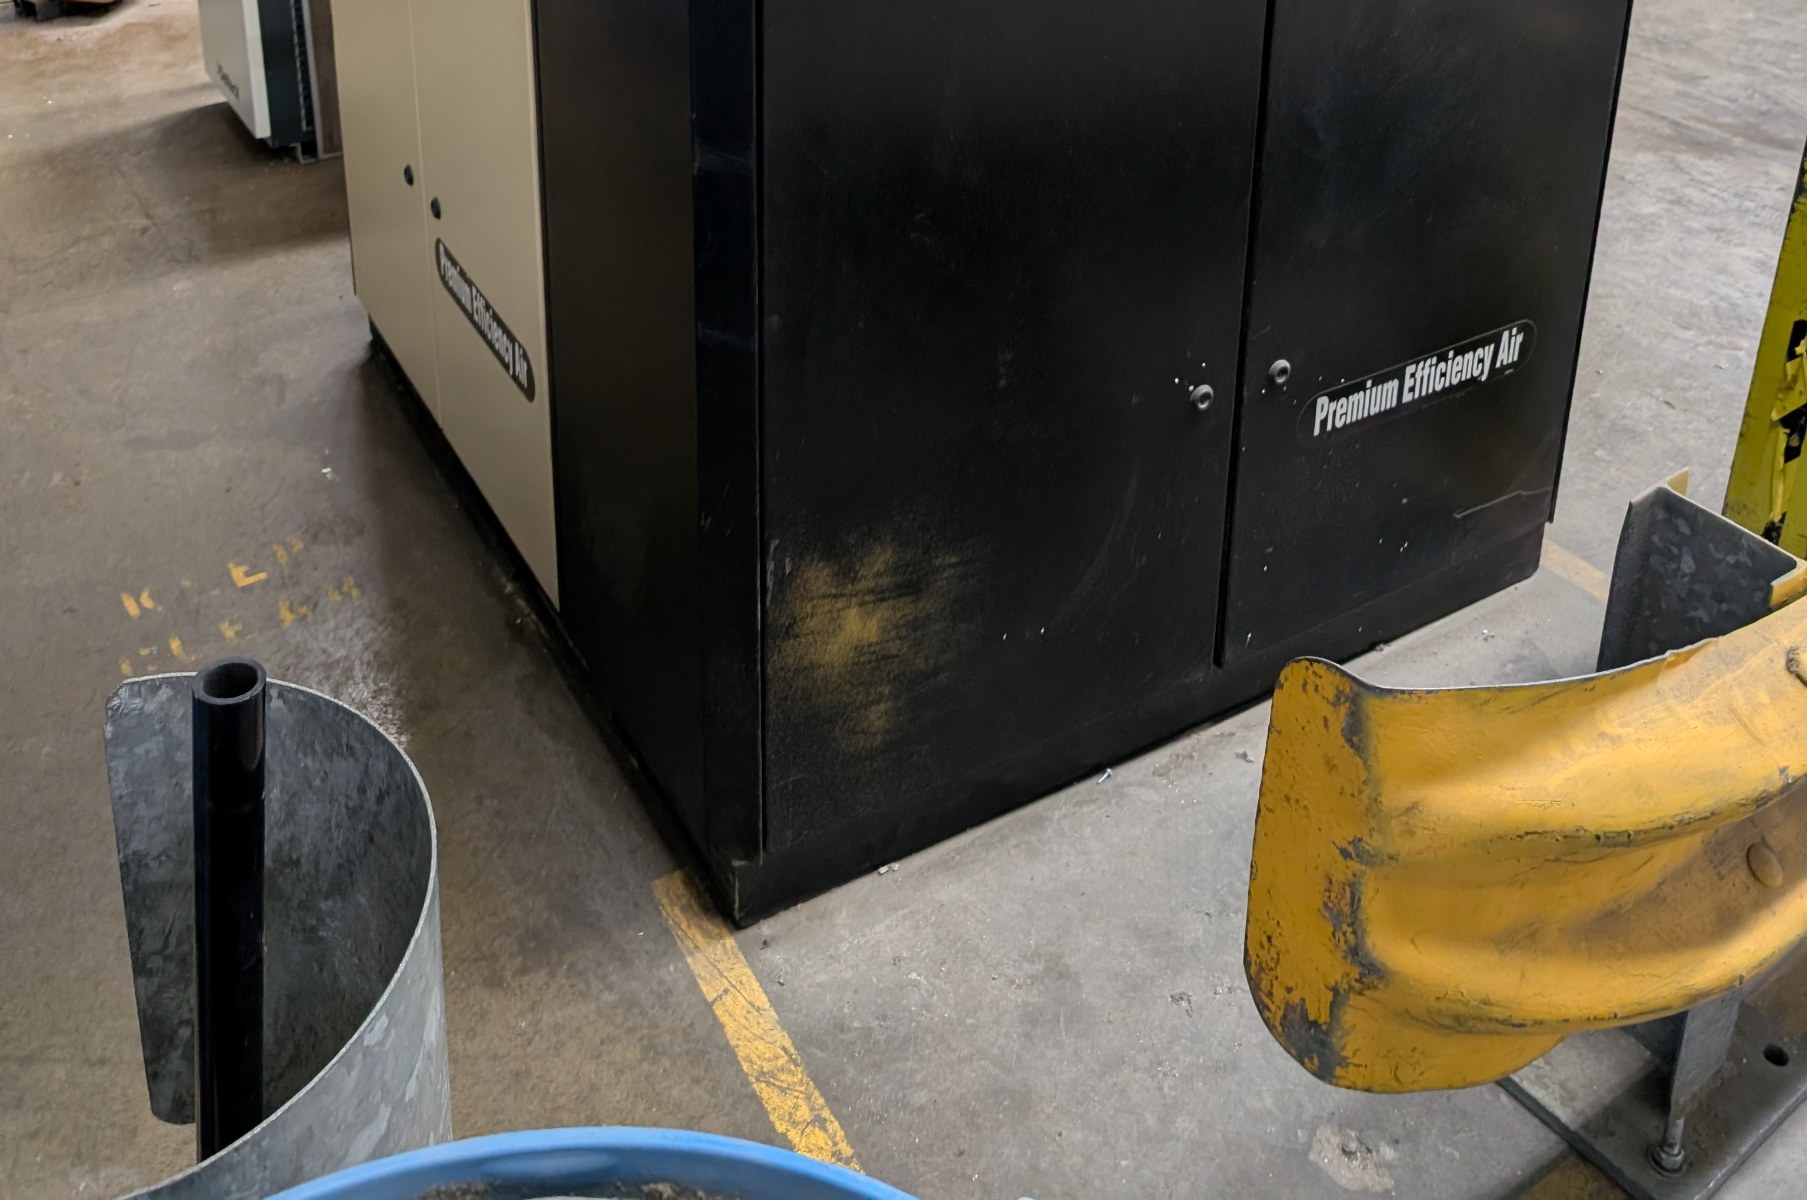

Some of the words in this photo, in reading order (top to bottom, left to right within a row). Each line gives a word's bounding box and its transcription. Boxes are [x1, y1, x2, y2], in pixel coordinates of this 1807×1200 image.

[471, 284, 514, 376] Efficiency
[514, 341, 528, 388] Air
[1313, 378, 1400, 437] Premium
[1401, 342, 1496, 404] Efficiency
[1494, 326, 1525, 369] Air
